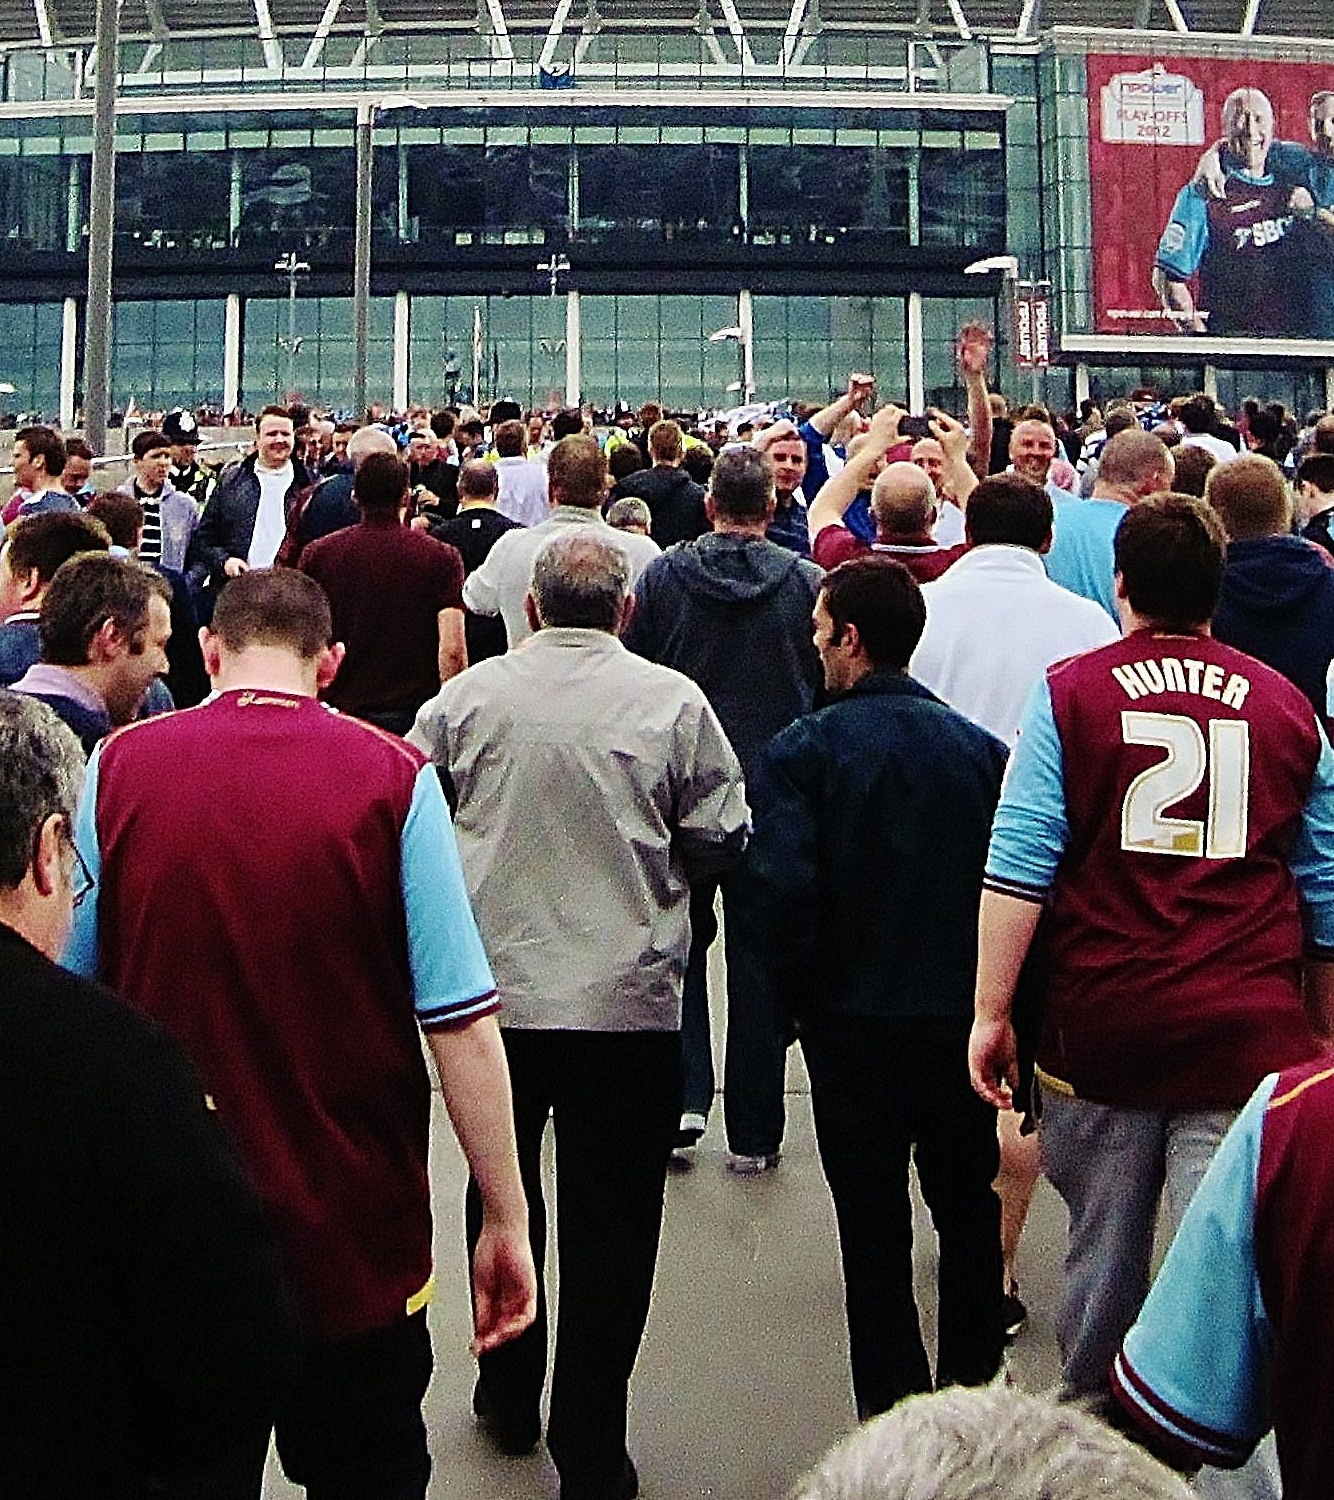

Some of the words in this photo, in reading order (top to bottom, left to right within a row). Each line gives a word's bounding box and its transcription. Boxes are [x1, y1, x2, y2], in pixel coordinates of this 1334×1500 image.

[1115, 108, 1188, 125] PLAY-OFFS
[1136, 125, 1172, 138] 2012
[1111, 657, 1251, 710] HUNTER
[1120, 711, 1250, 859] 21
